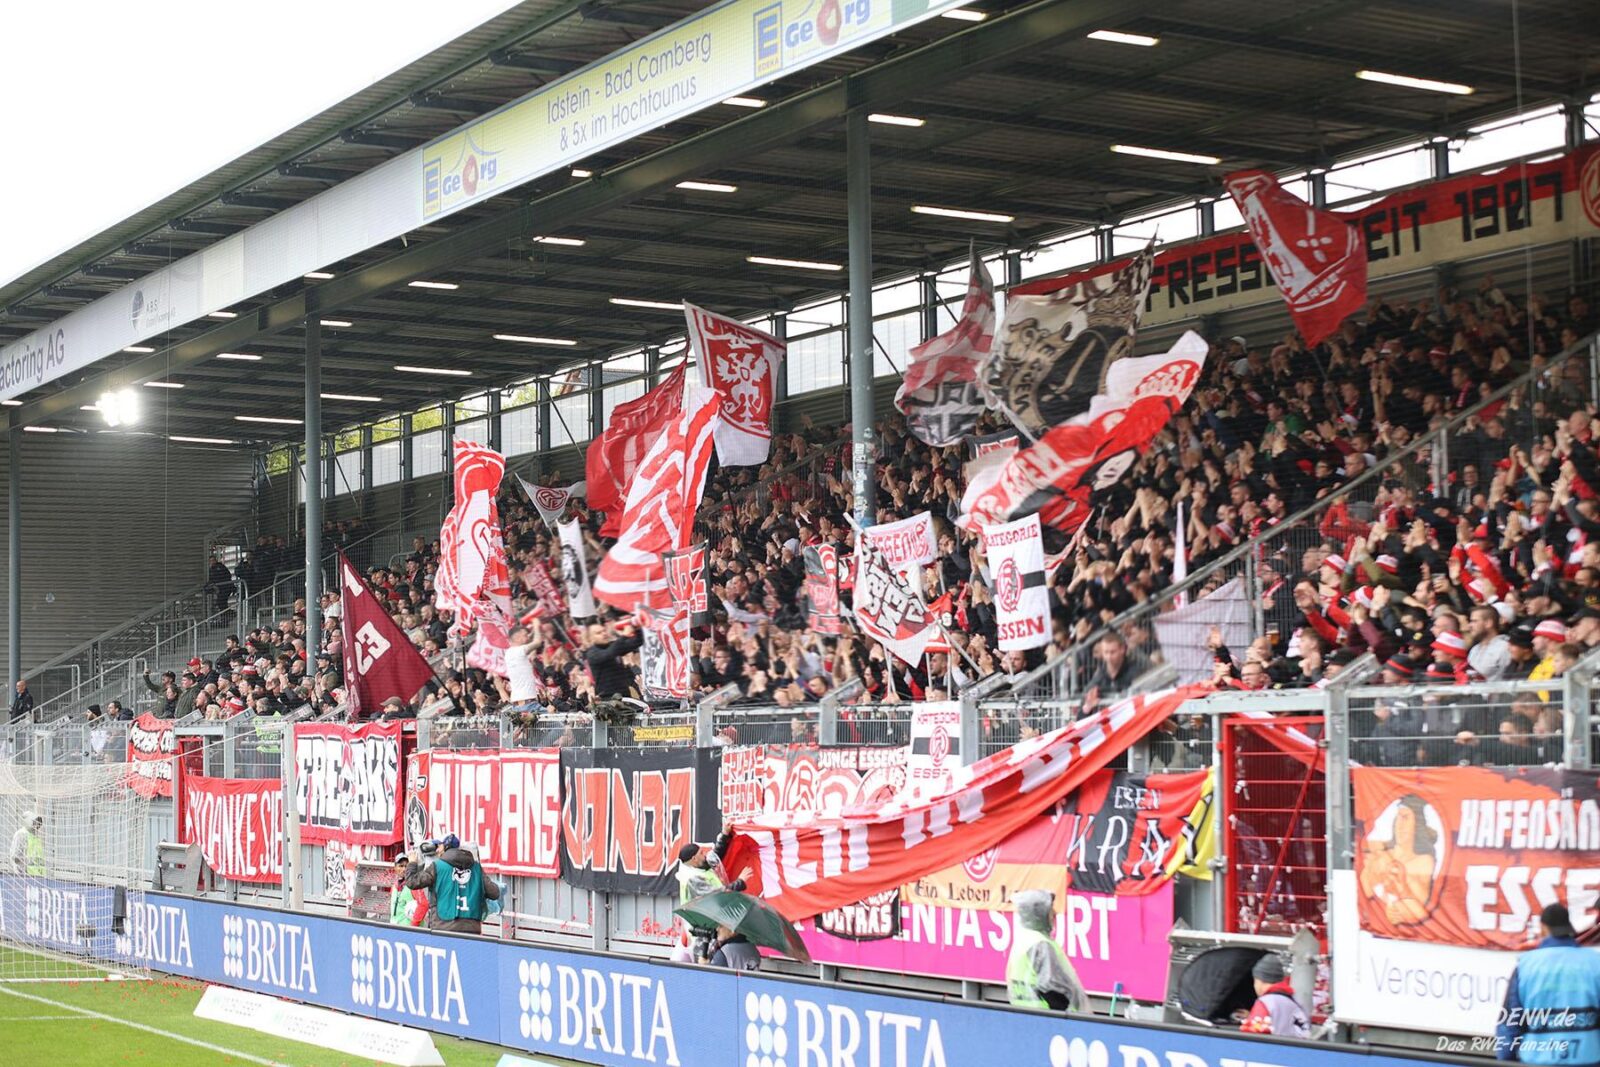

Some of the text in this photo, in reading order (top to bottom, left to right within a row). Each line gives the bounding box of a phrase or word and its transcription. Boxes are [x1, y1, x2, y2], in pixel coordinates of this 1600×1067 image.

[547, 85, 590, 124] Idstein
[605, 62, 633, 98] Bad
[637, 32, 712, 83] Camberg
[560, 75, 697, 151] & 5x im Hochtaunus
[1146, 170, 1563, 313] FRESS EIT 1907
[46, 328, 64, 370] AG
[817, 750, 858, 769] JUNGE
[201, 790, 258, 877] DANKE
[42, 888, 92, 948] BRITA
[821, 903, 893, 937] ULTRAS
[949, 882, 990, 902] Leben
[988, 893, 1117, 962] SRT
[134, 901, 194, 968] BRITA
[246, 918, 319, 994] BRITA
[376, 938, 480, 1026] BRITA
[556, 964, 681, 1067] BRITA
